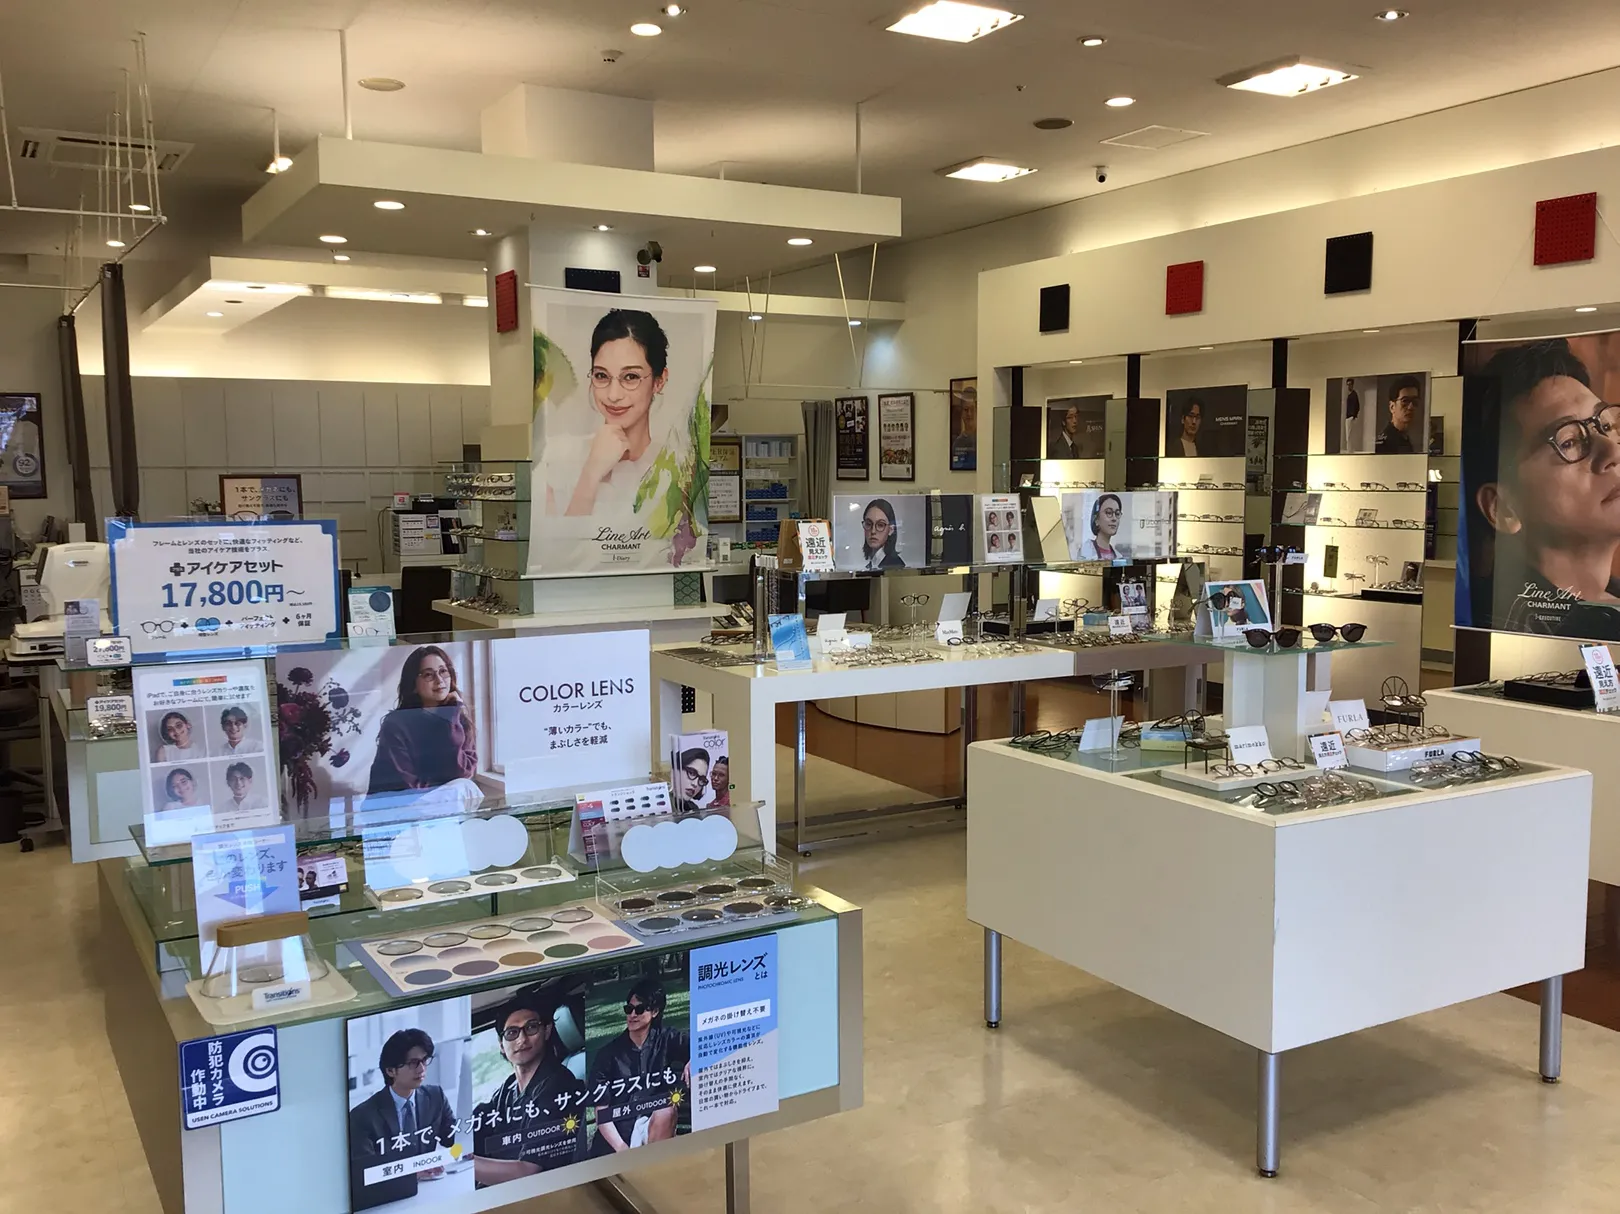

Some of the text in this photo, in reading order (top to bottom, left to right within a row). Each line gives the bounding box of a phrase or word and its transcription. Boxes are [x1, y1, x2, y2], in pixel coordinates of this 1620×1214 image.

[592, 526, 651, 542] Line Art
[187, 560, 284, 575] アイケアセット
[1518, 582, 1551, 600] Line
[1527, 601, 1571, 610] CHARMANT
[519, 678, 635, 703] COLOR LENS
[553, 700, 603, 714] カラーレンズ
[1338, 714, 1364, 724] FURLA
[549, 734, 608, 750] まぶしさを軽減
[1234, 742, 1266, 750] marimekko
[1424, 750, 1444, 758] FURLA
[235, 884, 261, 894] PUSH
[698, 952, 768, 982] 調光レンズ
[754, 970, 768, 980] とは
[702, 1005, 766, 1025] メガネの掛け替え不要
[208, 1040, 225, 1106] 防犯カメラ
[190, 1068, 206, 1110] 作動中
[192, 1101, 274, 1123] USEN CAMERA SOLUTIONS
[376, 1066, 677, 1156] 1本で、メガネにも、サングラスにも
[612, 1098, 667, 1118] 屋外 OUTDOOR
[502, 1124, 560, 1146] 車内 OUTDOOR
[382, 1155, 442, 1177] 室内 INDOOR
